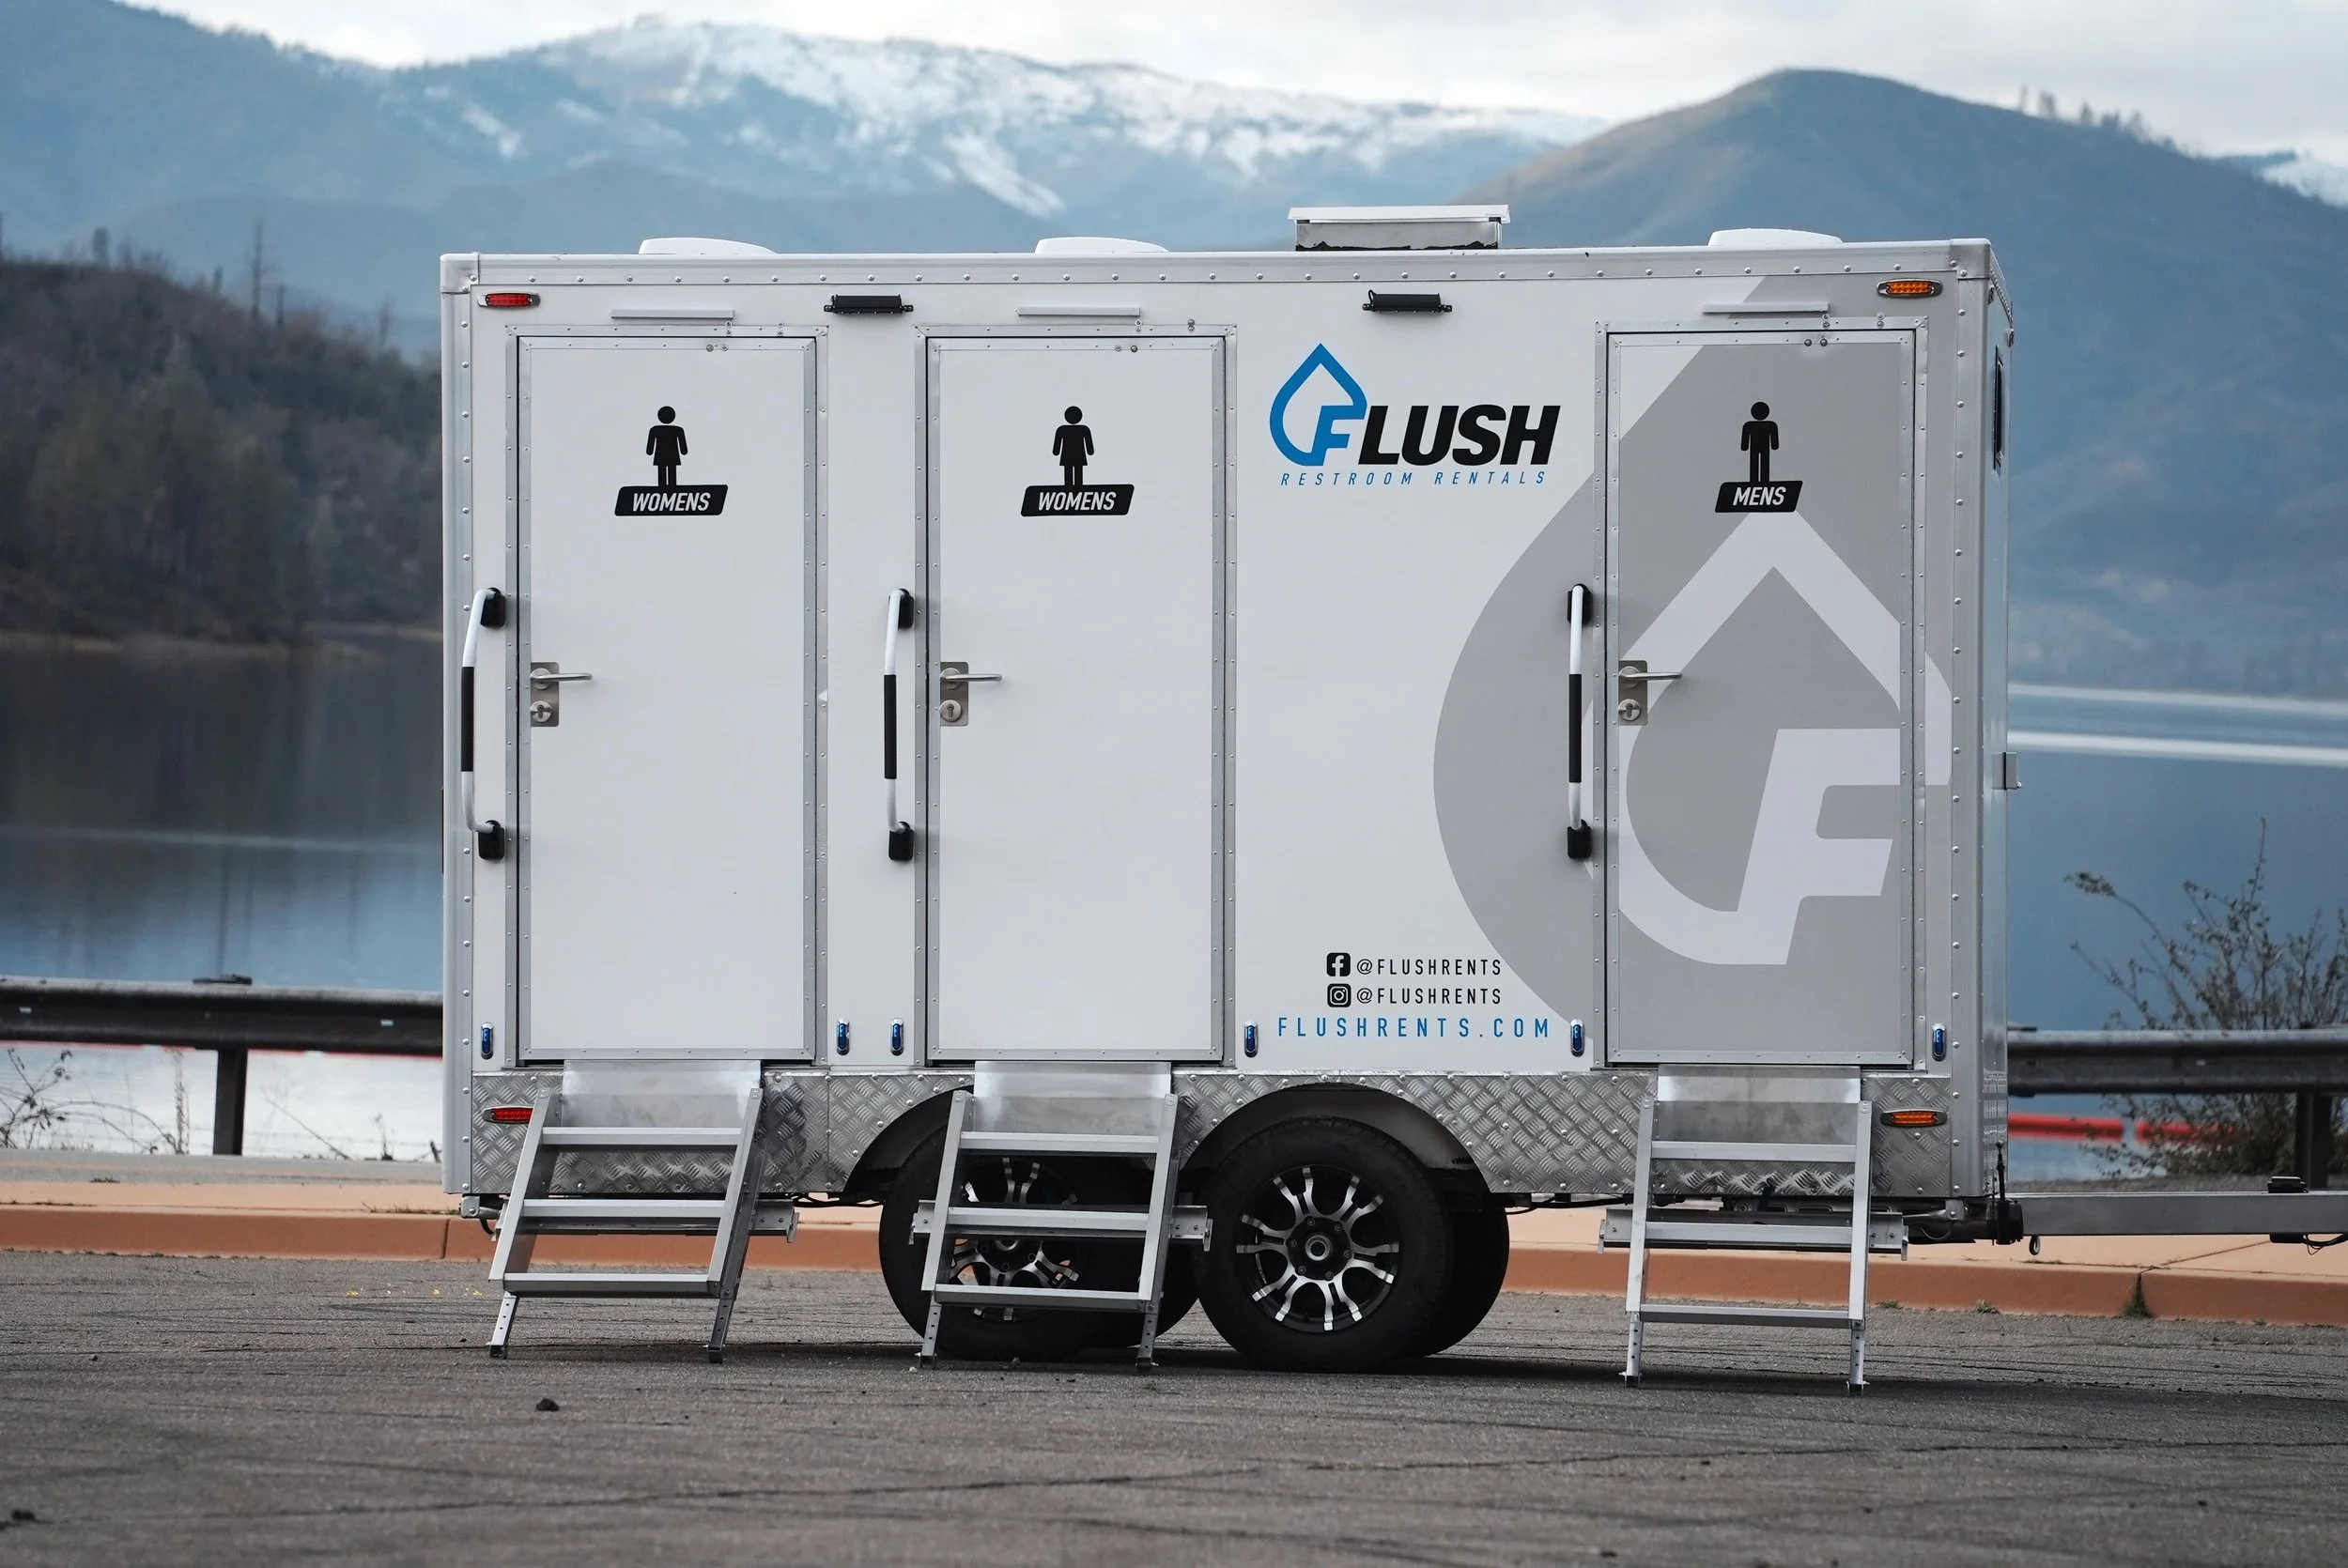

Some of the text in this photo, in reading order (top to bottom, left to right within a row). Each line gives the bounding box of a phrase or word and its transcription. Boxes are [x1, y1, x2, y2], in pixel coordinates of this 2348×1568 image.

[1280, 470, 1545, 486] RESTROOM RENTALS
[632, 492, 711, 512] WOMENS
[1038, 490, 1117, 511] WOMENS
[1732, 486, 1786, 506] MENS
[1356, 959, 1501, 976] @FLUSHRENTS
[1356, 988, 1501, 1005] @FLUSHRENTS
[1277, 1016, 1550, 1038] FLUSHRENTS.COM
